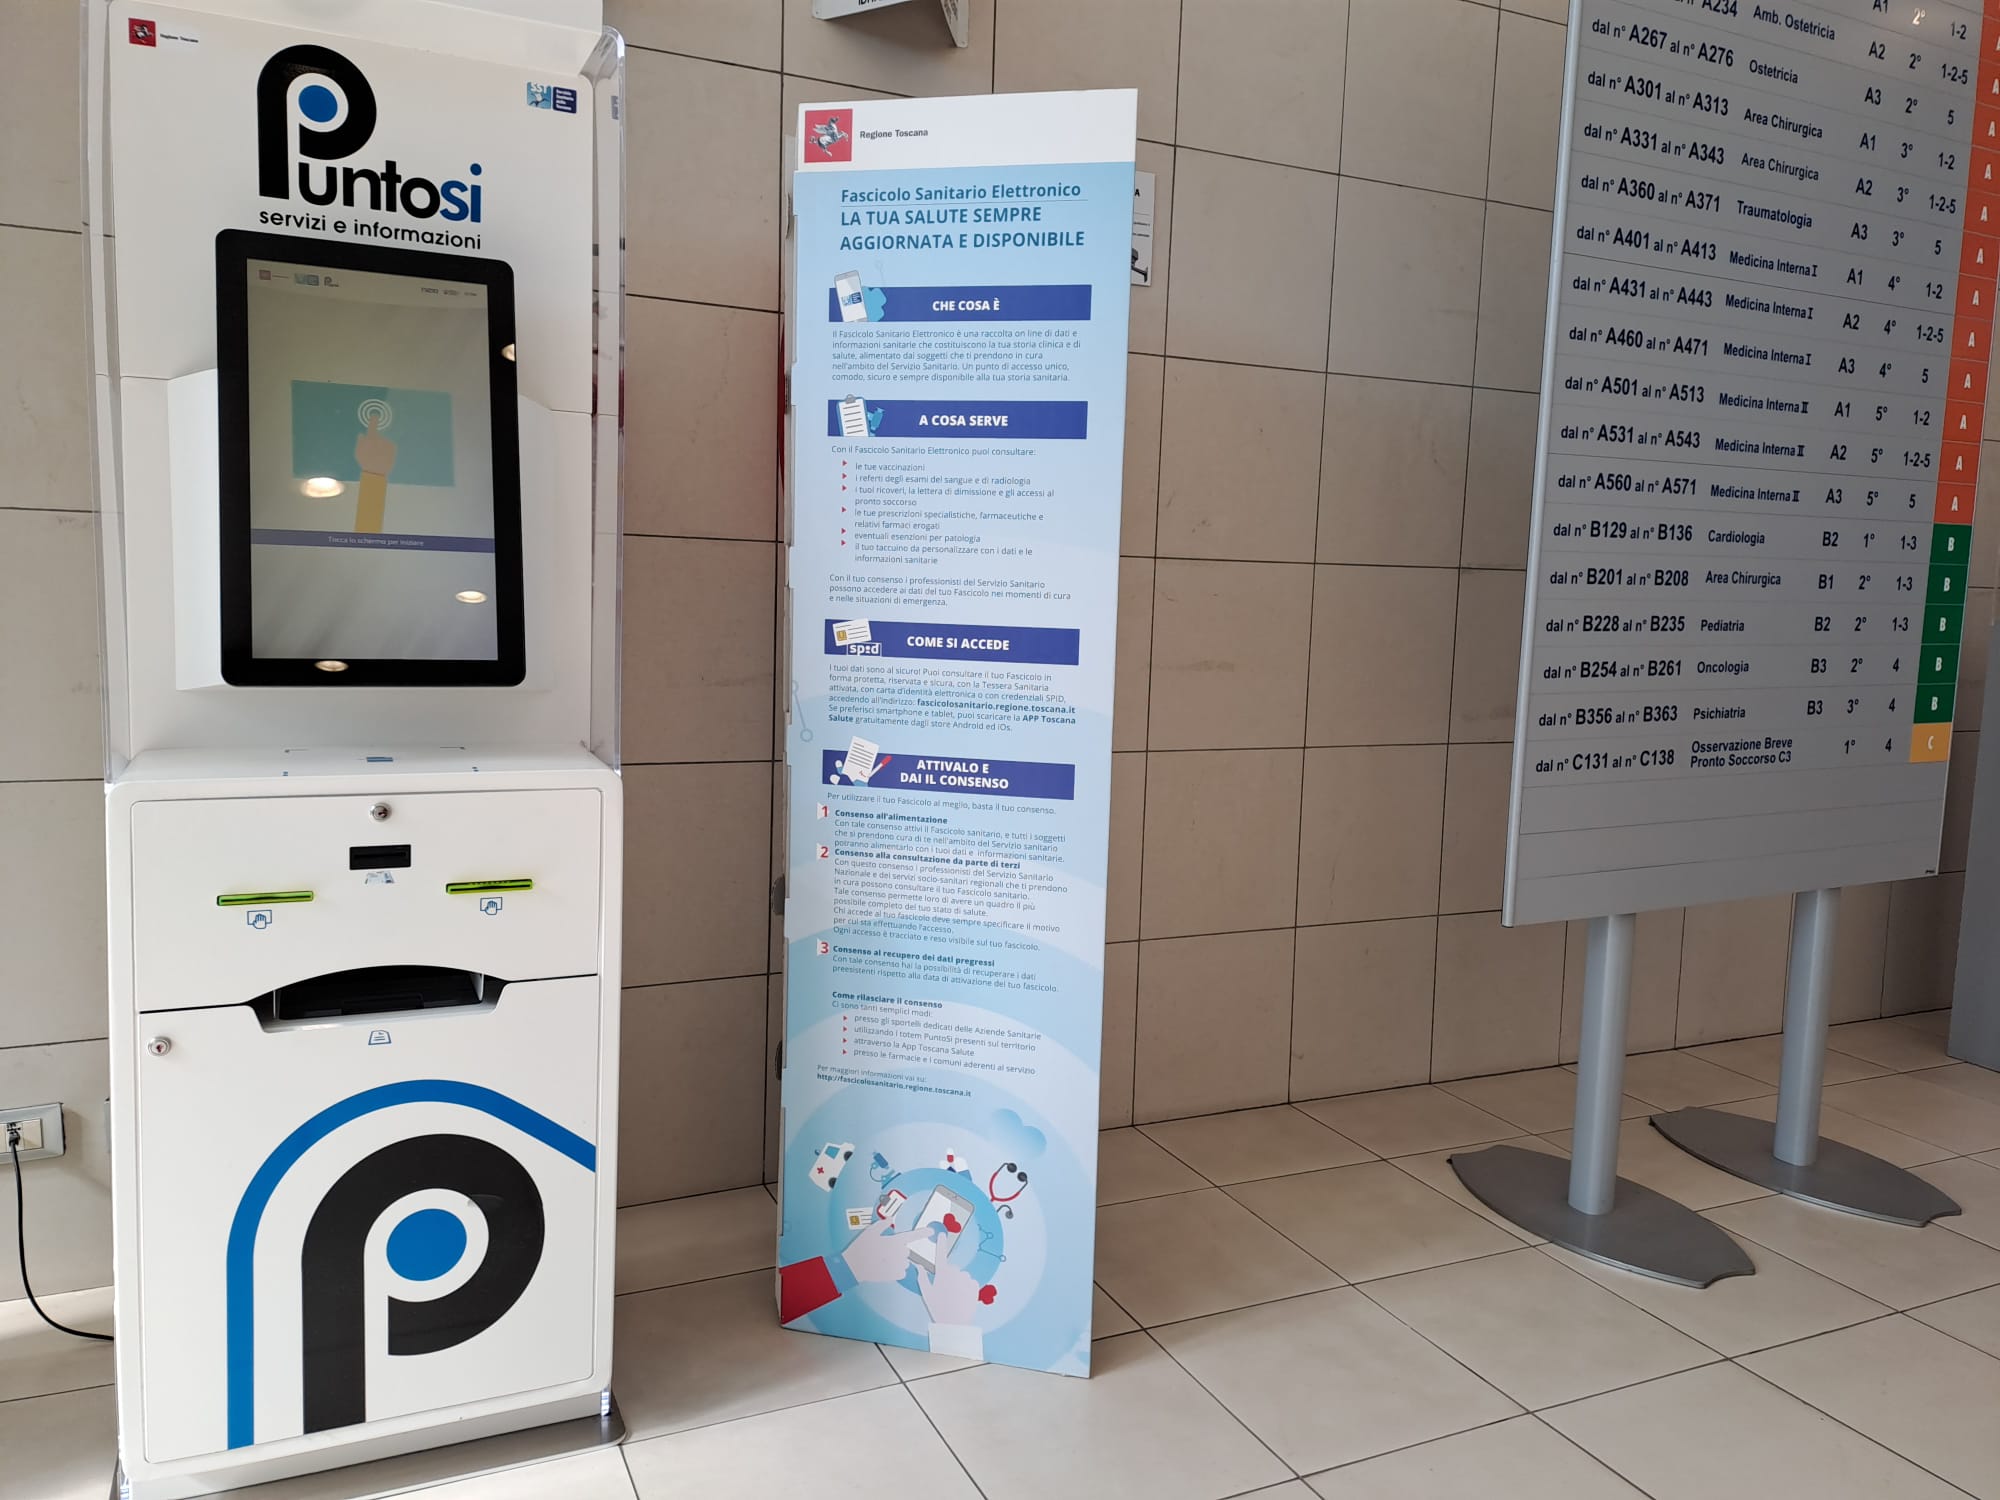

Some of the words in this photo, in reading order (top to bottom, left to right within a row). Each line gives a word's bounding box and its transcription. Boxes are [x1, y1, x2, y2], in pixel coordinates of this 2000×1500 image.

[1753, 5, 1782, 26] Amb.
[1785, 13, 1836, 41] Ostetricia
[1868, 41, 1886, 60] A2
[1628, 24, 1668, 49] A267
[1697, 42, 1734, 67] A276
[1749, 59, 1798, 84] Ostetricia
[1864, 86, 1881, 106] A3
[1623, 75, 1661, 100] A301
[1692, 91, 1728, 116] A313
[1743, 108, 1768, 125] Area
[1771, 114, 1822, 138] Chirurgica
[1859, 132, 1876, 151] A1
[860, 130, 893, 140] Regione
[895, 128, 929, 137] Toscana
[1619, 126, 1657, 151] A331
[1687, 141, 1724, 165] A343
[1741, 152, 1765, 169] Area
[1767, 158, 1819, 181] Chirurgica
[1855, 177, 1873, 196] A2
[841, 186, 910, 202] Fascicolo
[914, 184, 986, 200] Sanitario
[991, 181, 1080, 198] Elettronico
[841, 211, 861, 225] LA
[865, 210, 900, 225] TUA
[904, 208, 968, 224] SALUTE
[972, 206, 1041, 223] SEMPRE
[1616, 177, 1655, 200] A360
[1684, 190, 1720, 212] A371
[1736, 199, 1812, 229] Traumatologia
[1850, 222, 1868, 240] A3
[260, 210, 326, 231] servizi
[334, 221, 347, 233] e
[354, 219, 481, 250] informazioni
[839, 233, 953, 250] AGGIORNATA
[959, 233, 967, 248] E
[973, 230, 1084, 247] DISPONIBILE
[1612, 227, 1649, 250] A401
[1680, 238, 1716, 261] A413
[1729, 250, 1774, 270] Medicina
[1846, 267, 1863, 285] A1
[932, 300, 955, 310] CHE
[957, 300, 990, 310] COSA
[993, 297, 999, 310] È
[1608, 276, 1646, 298] A431
[1676, 286, 1712, 308] A443
[1725, 293, 1770, 313] Medicina
[1842, 312, 1860, 330] A2
[1600, 375, 1637, 396] A501
[1668, 383, 1704, 403] A513
[1718, 392, 1763, 409] Medicina
[1834, 401, 1850, 418] A1
[918, 414, 928, 425] A
[931, 414, 966, 425] COSA
[969, 415, 1008, 426] SERVE
[1593, 472, 1632, 491] A560
[1661, 476, 1696, 495] A571
[1710, 484, 1755, 500] Medicina
[1825, 488, 1842, 504] A3
[1590, 520, 1627, 539] B129
[1657, 523, 1693, 541] B136
[1708, 529, 1765, 547] Cardiologia
[1822, 531, 1839, 547] B2
[1586, 567, 1622, 585] B201
[1654, 569, 1689, 586] B208
[1705, 570, 1729, 584] Area
[1731, 570, 1781, 588] Chirurgica
[1818, 573, 1834, 589] B1
[1582, 615, 1619, 632] B228
[1650, 615, 1685, 632] B235
[1700, 619, 1744, 632] Pediatria
[1814, 616, 1831, 632] B2
[907, 636, 943, 647] COME
[946, 637, 957, 648] SI
[960, 638, 1009, 650] ACCEDE
[1580, 660, 1617, 678] B254
[1647, 659, 1681, 676] B261
[1696, 660, 1749, 675] Oncologia
[1810, 658, 1827, 673] B3
[1575, 707, 1612, 725] B356
[1642, 705, 1678, 722] B363
[1693, 706, 1745, 720] Psichiatria
[1806, 700, 1823, 715] B3
[1691, 738, 1761, 753] Osservazione
[1764, 737, 1792, 749] Breve
[916, 759, 978, 773] ATTIVALO
[982, 763, 989, 773] E
[1572, 752, 1608, 770] C131
[1639, 749, 1674, 766] C138
[1690, 755, 1725, 768] Pronto
[1727, 753, 1776, 766] Soccorso
[1778, 750, 1791, 763] C3
[900, 772, 921, 783] DAI
[925, 773, 936, 784] IL
[939, 774, 1008, 789] CONSENSO
[822, 805, 828, 817] 1
[835, 809, 873, 819] Consenso
[876, 812, 947, 823] all'alimentazione
